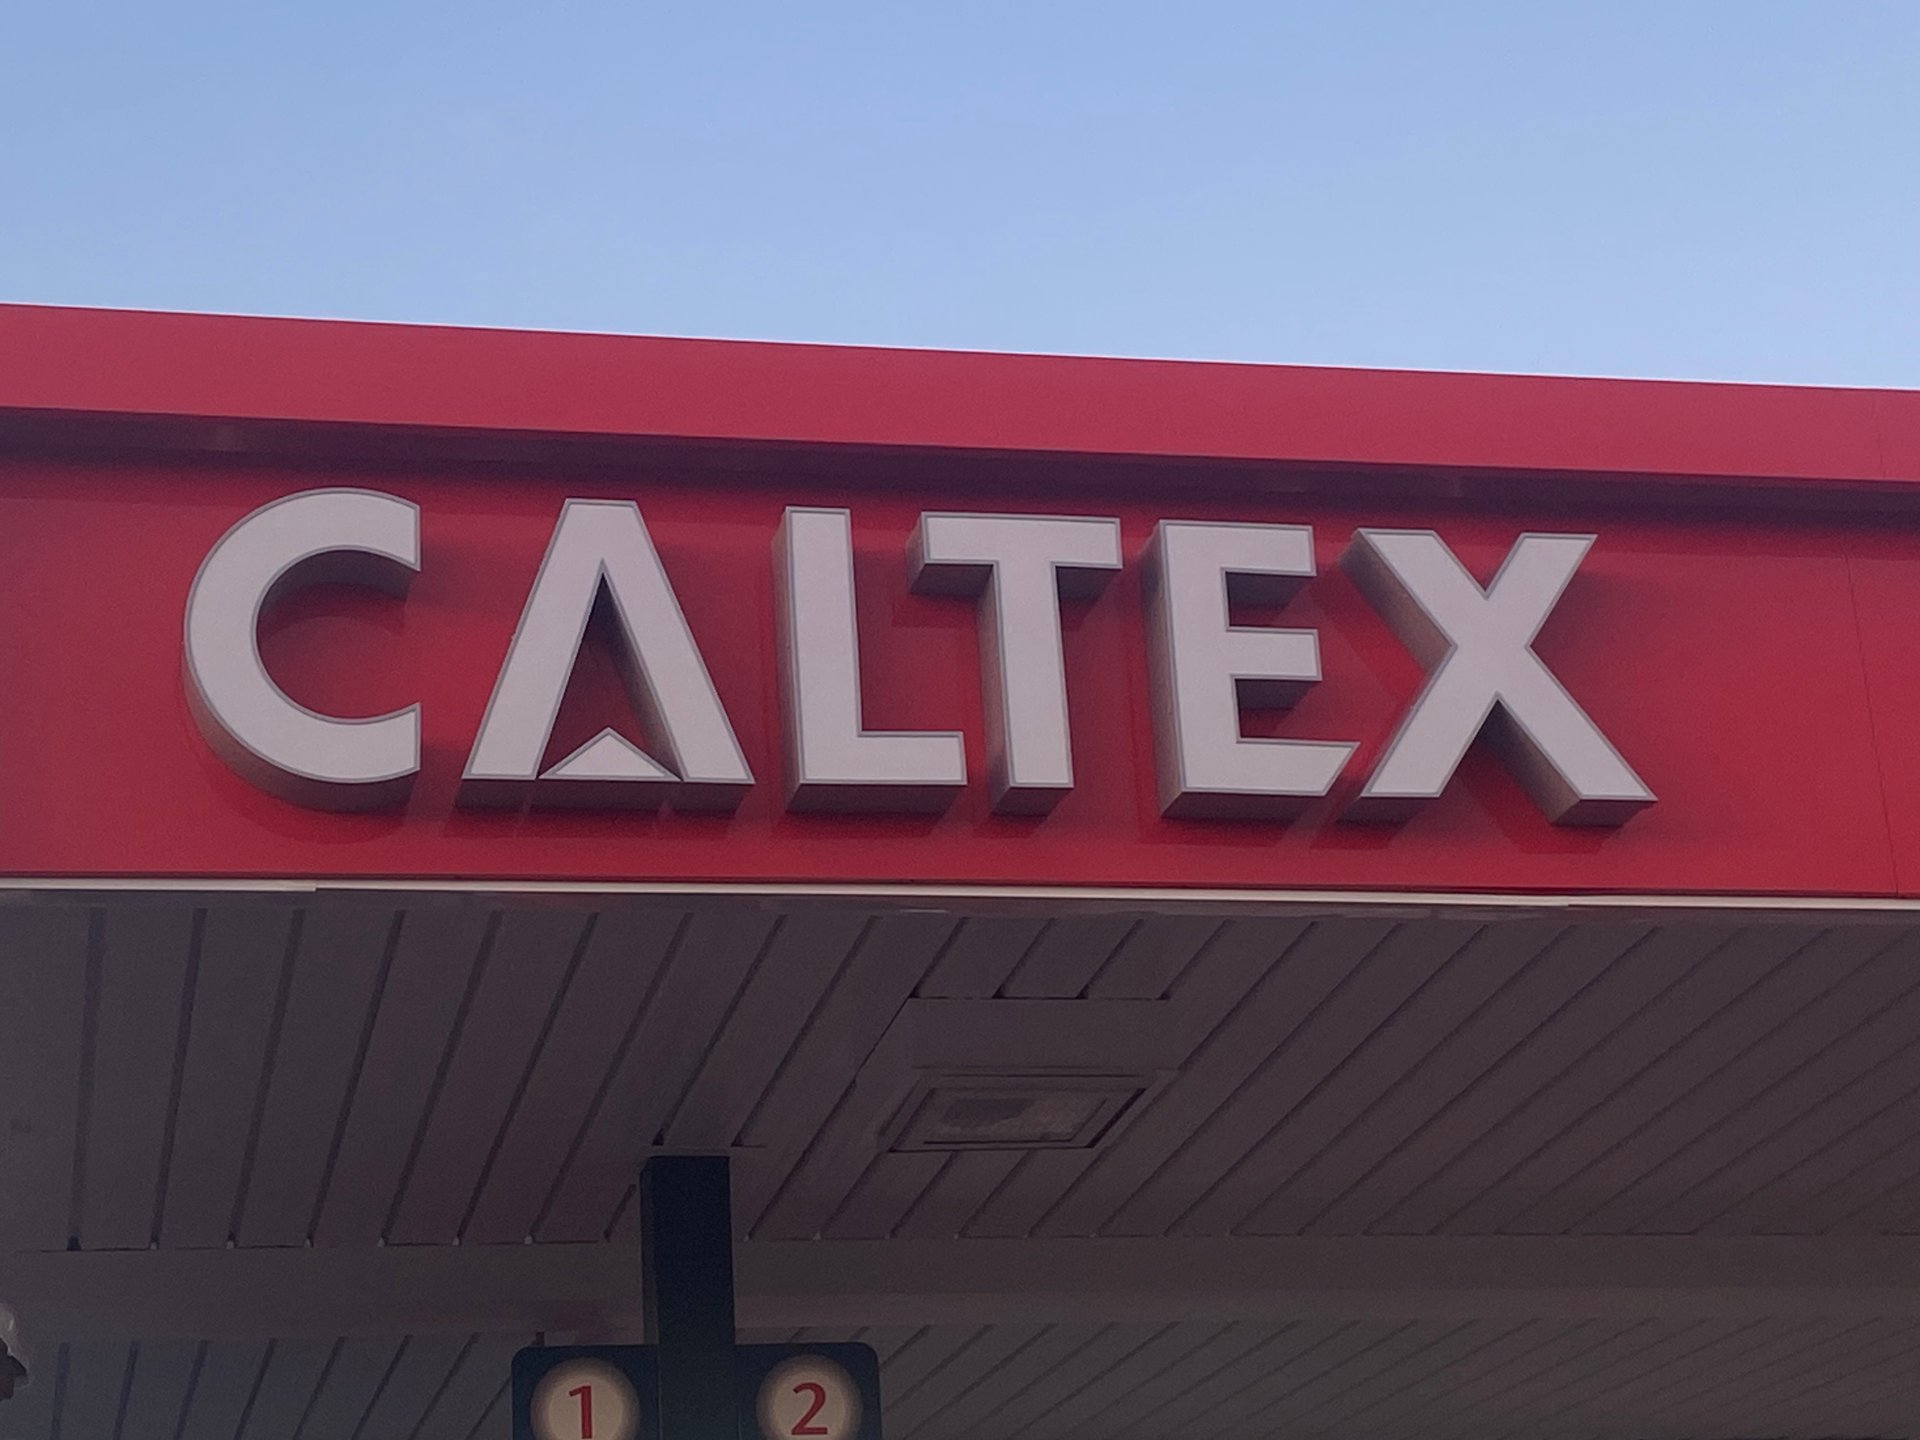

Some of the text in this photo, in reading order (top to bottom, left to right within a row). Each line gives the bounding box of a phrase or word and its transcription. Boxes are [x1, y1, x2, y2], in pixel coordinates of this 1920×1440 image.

[184, 487, 1658, 803] CALTEX
[568, 1385, 593, 1439] 1
[791, 1381, 828, 1435] 2
